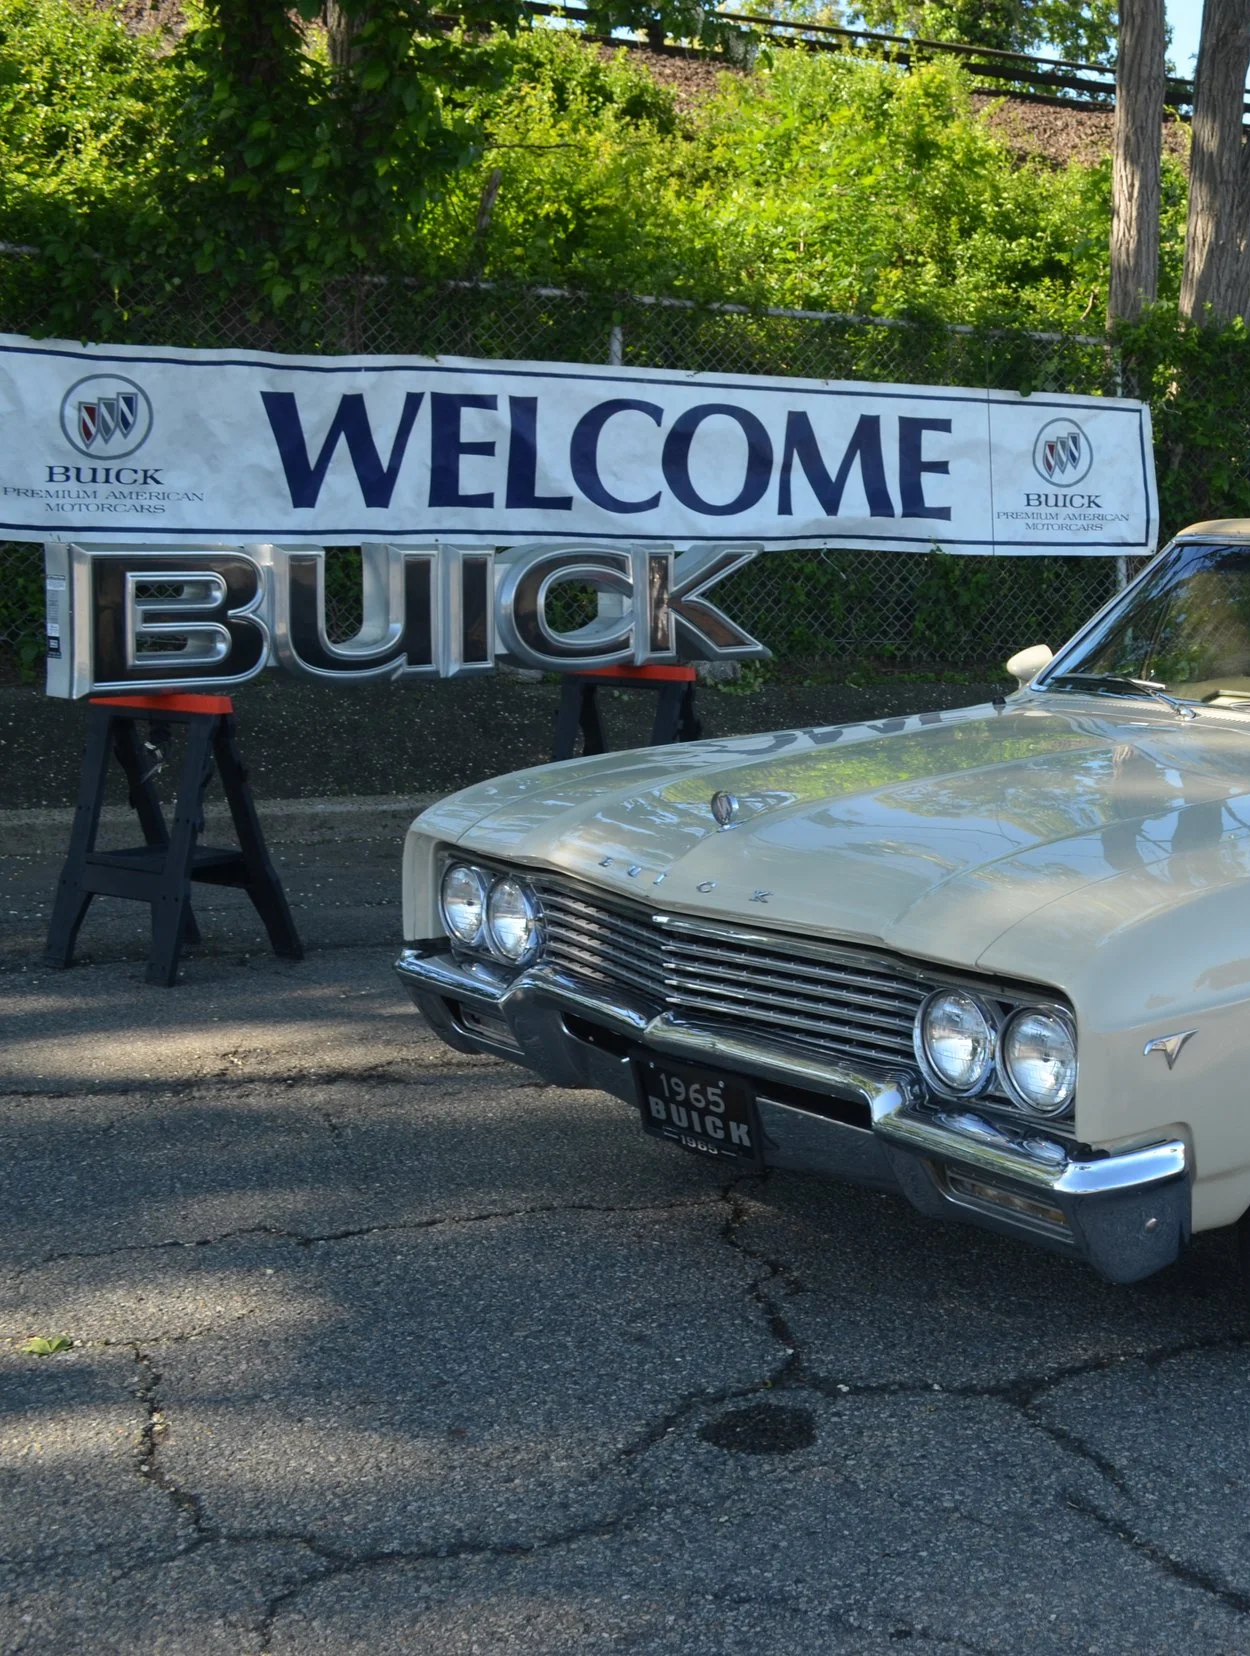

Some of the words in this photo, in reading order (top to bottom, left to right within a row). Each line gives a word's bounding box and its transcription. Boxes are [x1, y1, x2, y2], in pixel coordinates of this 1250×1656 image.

[261, 391, 952, 521] WELCOME
[45, 465, 164, 486] BUICK
[3, 486, 98, 500] PREMIUM
[104, 490, 204, 502] AMERICAN
[1024, 493, 1102, 508] BUICK
[45, 503, 166, 513] MOTORCARS
[997, 512, 1058, 521] PREMIUM
[1063, 513, 1129, 522] AMERICAN
[1025, 522, 1103, 531] MOTORCARS
[47, 542, 773, 700] BUICK
[598, 857, 774, 904] BUICK
[660, 1073, 725, 1113] 1965
[648, 1095, 751, 1147] BUICK
[680, 1135, 718, 1155] 1965
